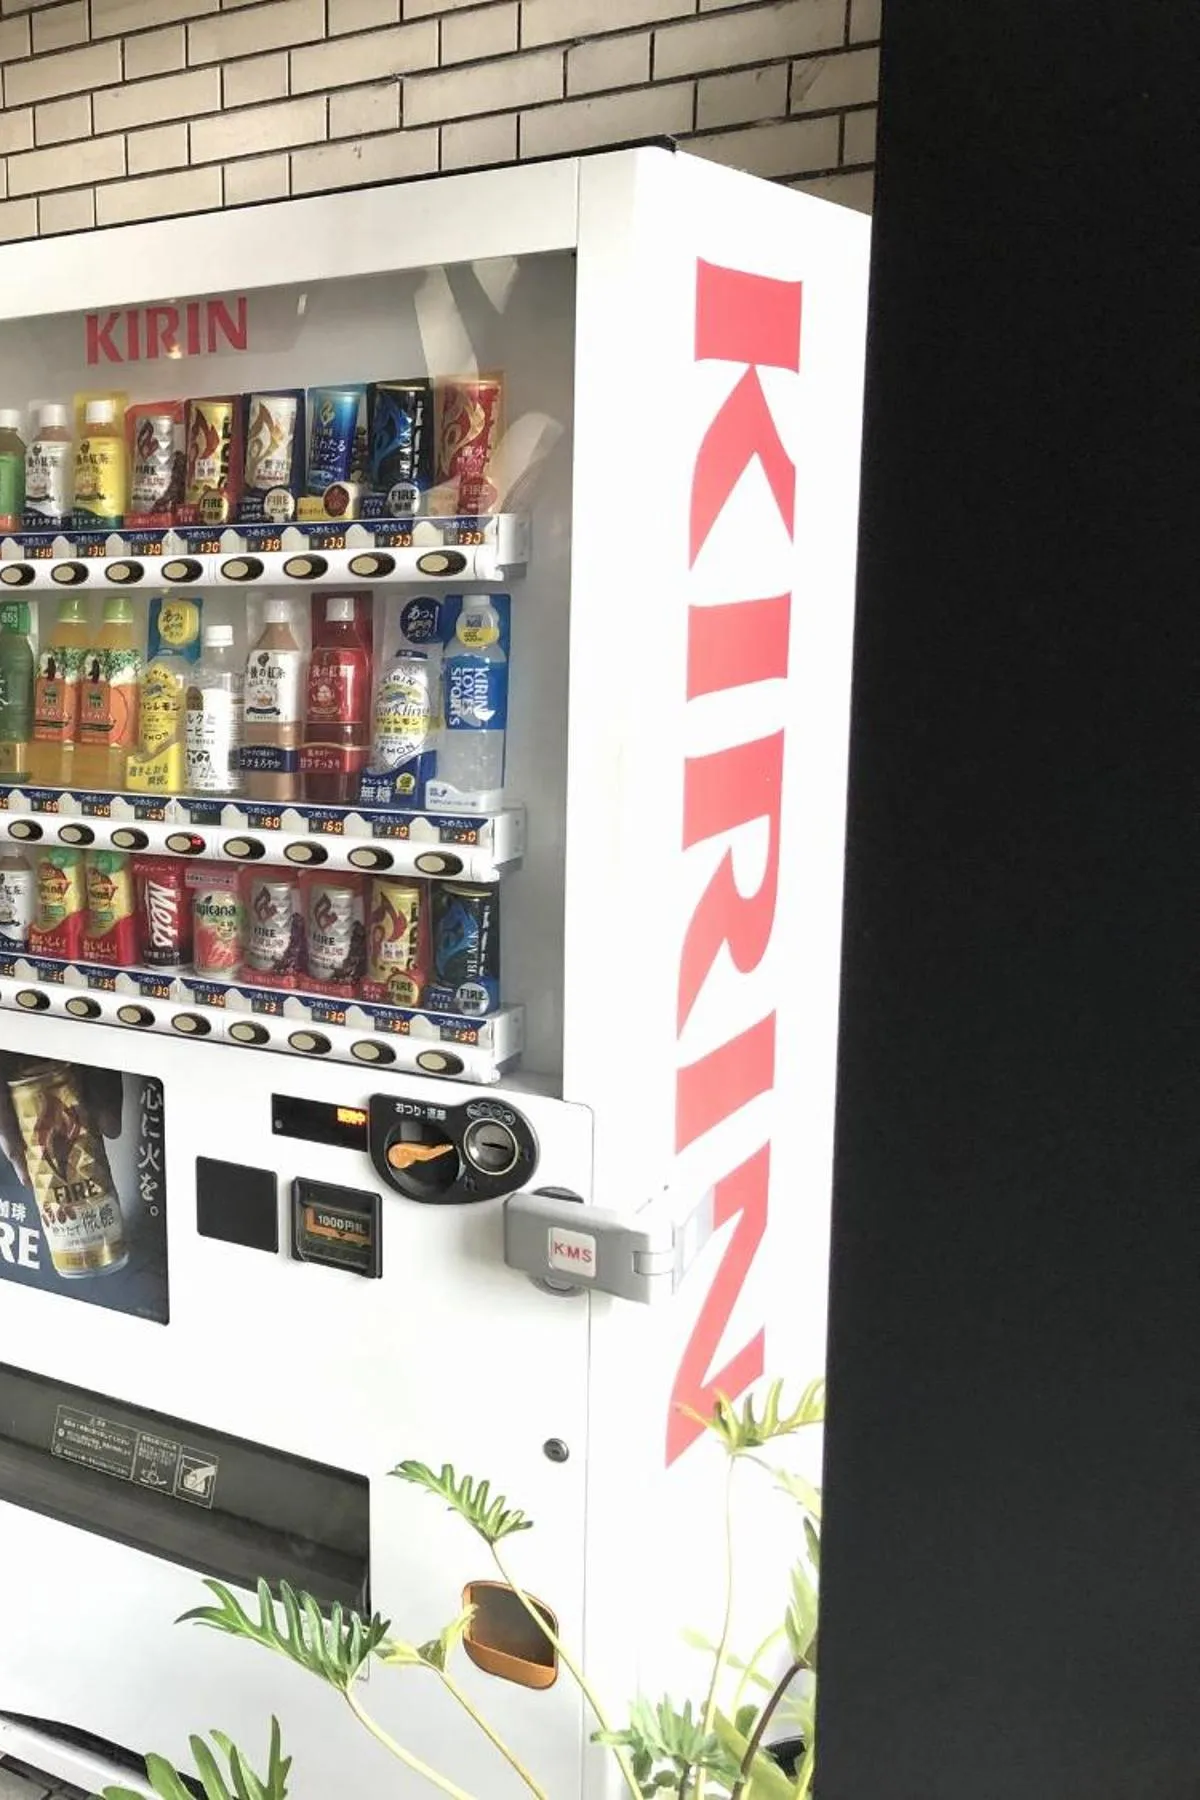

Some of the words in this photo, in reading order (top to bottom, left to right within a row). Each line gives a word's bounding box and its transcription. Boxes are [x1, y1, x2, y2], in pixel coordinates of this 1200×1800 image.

[85, 295, 248, 366] KIRIN
[391, 489, 417, 500] FIRE
[308, 525, 341, 535] つめたい
[374, 521, 408, 533] つめたい
[323, 536, 344, 549] 130
[389, 533, 412, 547] 130
[459, 532, 483, 545] 130
[88, 543, 106, 557] 130
[142, 542, 161, 556] 130
[200, 540, 221, 554] 130
[260, 539, 280, 552] 130
[308, 810, 340, 820] つめたい
[371, 814, 404, 825] つめたい
[440, 820, 474, 830] つめたい
[663, 256, 803, 1469] KIRIN
[148, 879, 179, 948] Mets
[460, 988, 487, 1001] FIRE
[309, 1000, 340, 1010] つめたい
[372, 1008, 405, 1020] つめたい
[439, 1018, 473, 1030] つめたい
[138, 1083, 164, 1218] 心に火を。
[555, 1243, 593, 1263] KMS
